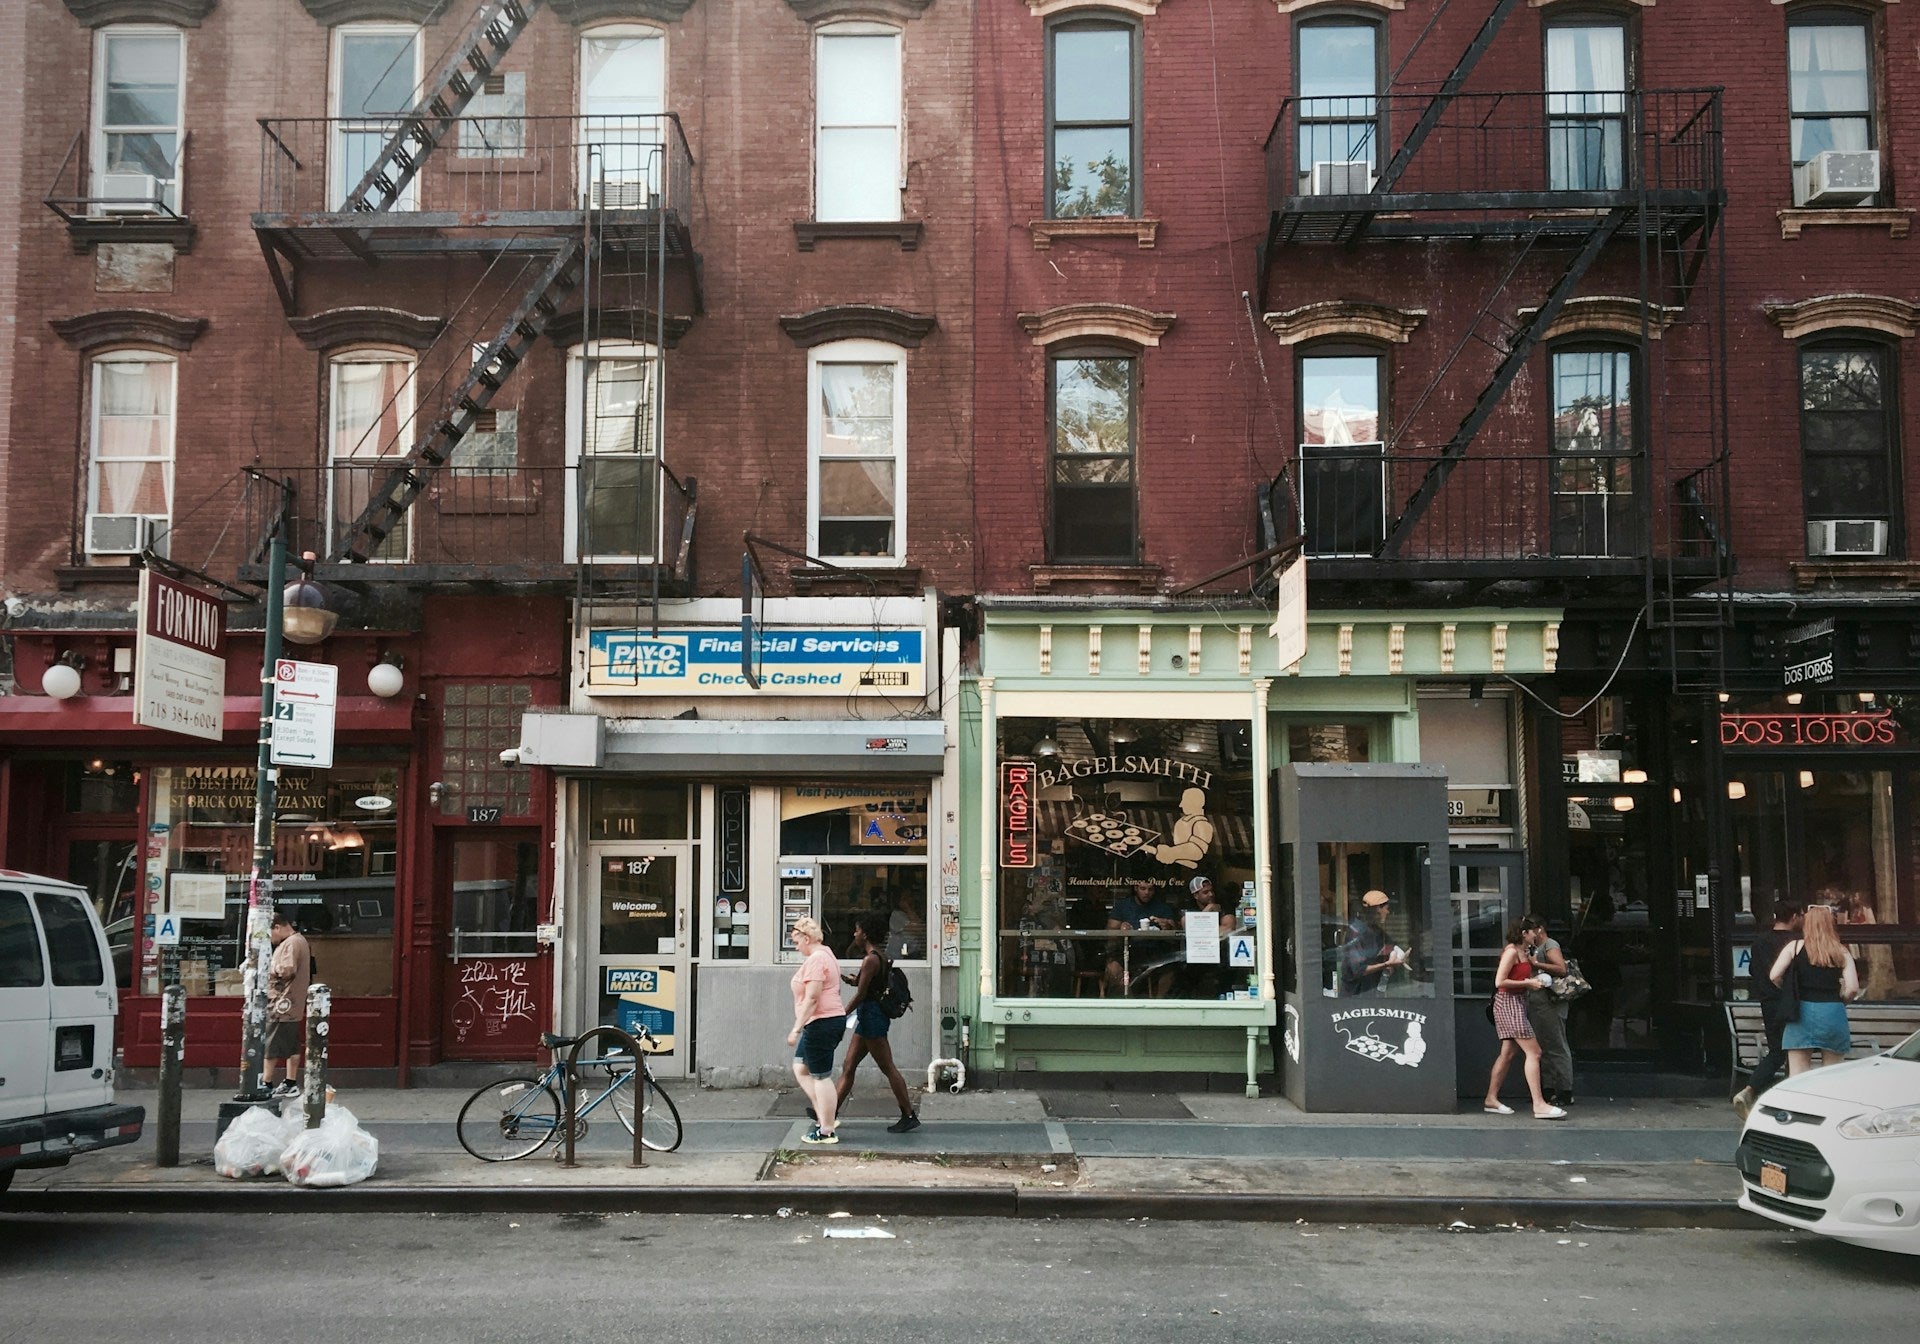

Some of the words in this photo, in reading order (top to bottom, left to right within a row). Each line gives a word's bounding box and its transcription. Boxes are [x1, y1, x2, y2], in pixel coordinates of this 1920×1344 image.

[156, 583, 219, 650] FORNINO
[699, 638, 797, 653] Finacial
[802, 638, 899, 653] Services
[611, 660, 680, 675] MATIC
[1784, 668, 1802, 685] DOS
[1804, 659, 1833, 681] TOROS
[698, 672, 767, 685] Checs
[771, 672, 842, 685] Cashed
[1815, 675, 1833, 684] TAQUERIA
[151, 701, 167, 719] 718
[172, 706, 217, 731] 384-6004
[279, 703, 289, 719] 2
[303, 728, 314, 736] 7pm
[1721, 720, 1783, 744] DOS
[1795, 715, 1895, 744] TOROS
[276, 734, 296, 742] Except
[297, 735, 317, 744] Sunday
[1038, 756, 1213, 790] BAGELSMITH
[200, 777, 227, 790] BEST
[232, 777, 257, 790] PIZZ
[285, 777, 309, 790] NYC
[796, 787, 820, 797] Visit
[188, 795, 226, 808] BRICK
[302, 795, 326, 808] NYC
[472, 809, 498, 822] 187
[1009, 768, 1028, 864] BAGELS
[725, 794, 741, 886] OPEN
[626, 861, 650, 875] 187
[1067, 877, 1122, 887] Handcrafted
[1125, 877, 1145, 886] Since
[1148, 877, 1166, 888] Day
[1168, 877, 1185, 886] One
[612, 902, 657, 911] Welcome
[160, 919, 175, 936] A
[1234, 940, 1250, 958] A
[1738, 949, 1751, 968] A
[609, 981, 654, 991] MATIC
[1331, 1008, 1427, 1025] BAGELSMITH
